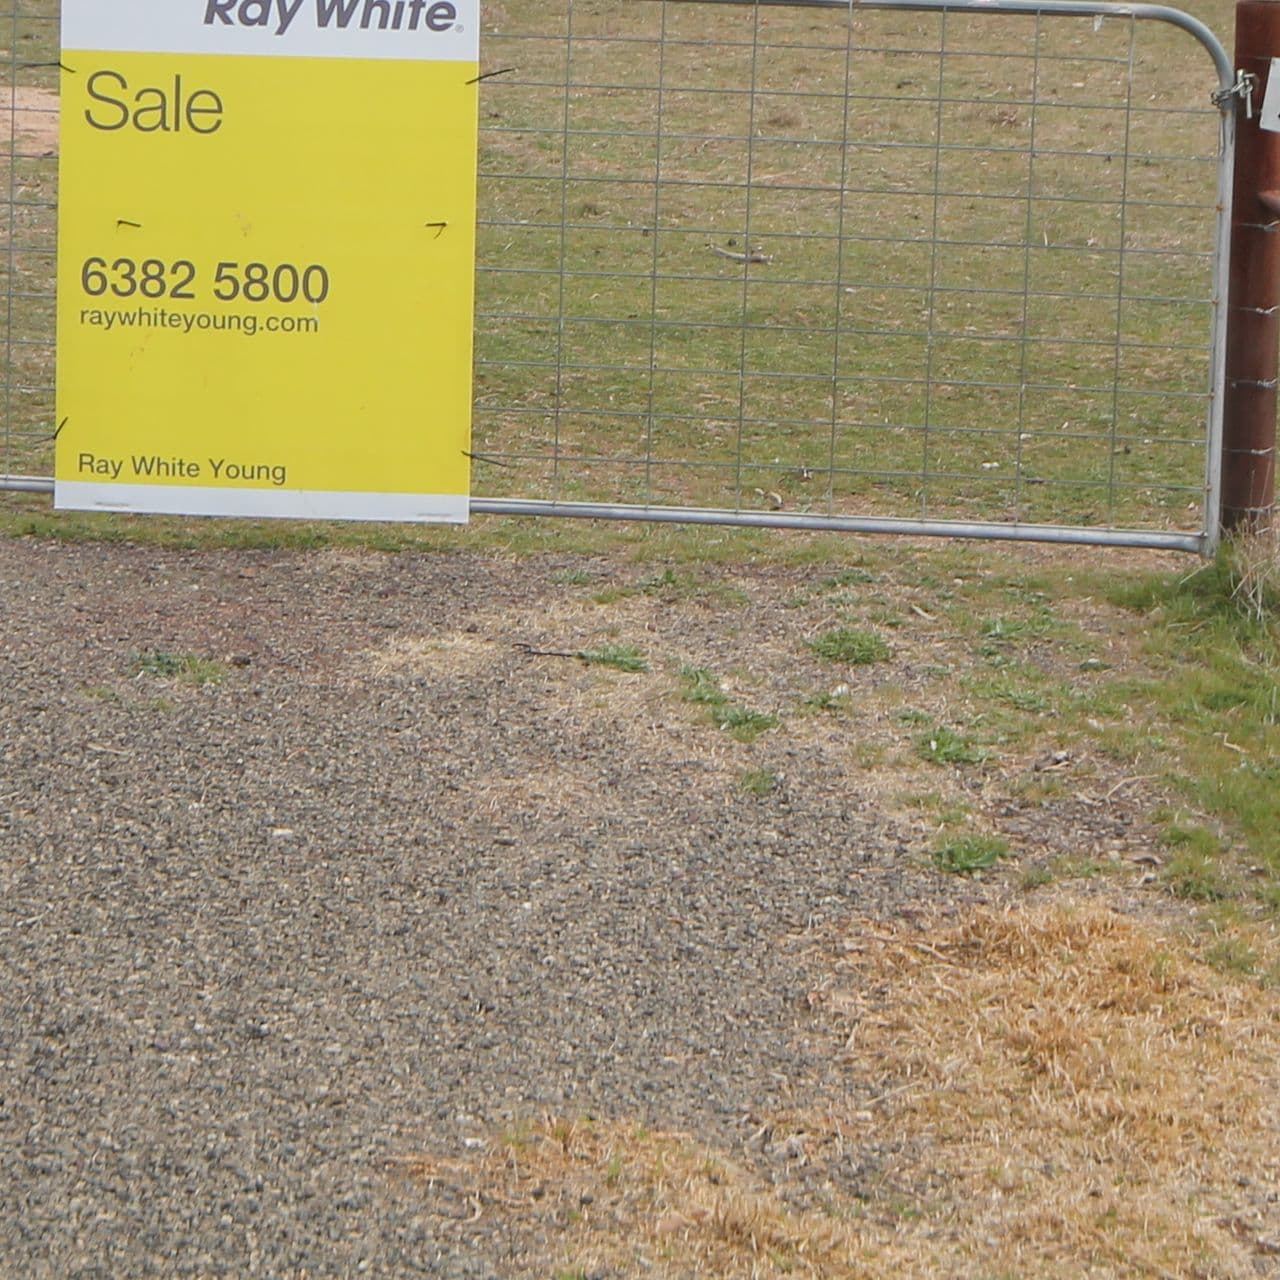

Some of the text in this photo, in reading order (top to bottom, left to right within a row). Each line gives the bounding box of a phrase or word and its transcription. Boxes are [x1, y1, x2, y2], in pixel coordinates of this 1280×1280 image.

[84, 70, 224, 134] Sale
[81, 257, 329, 303] 6382 5800
[80, 307, 318, 334] raywhiteyoung.com
[78, 453, 286, 486] Ray White Young
